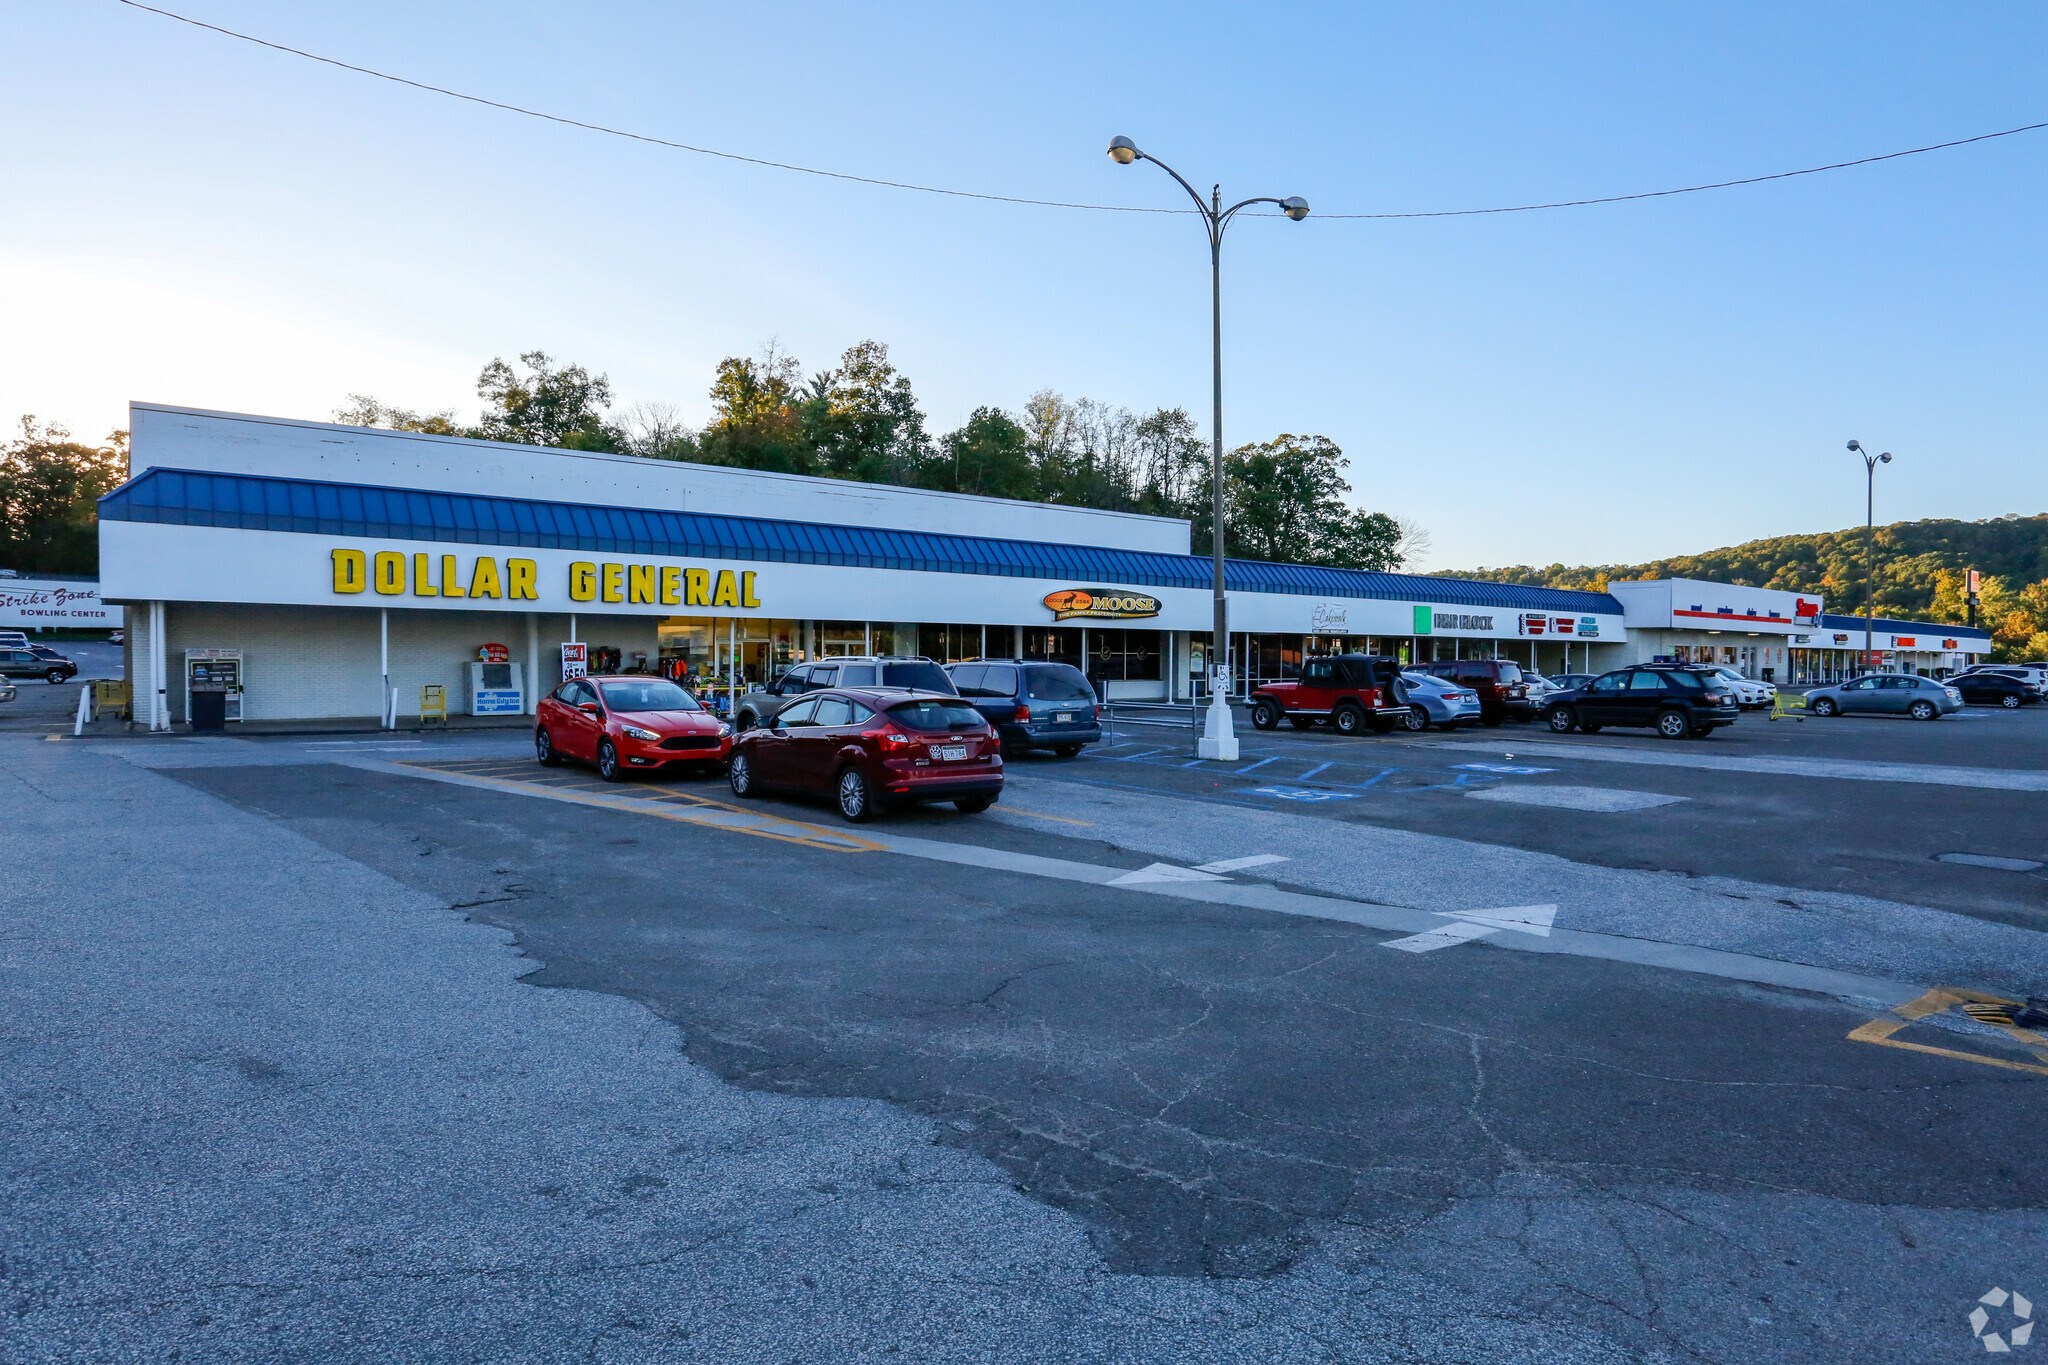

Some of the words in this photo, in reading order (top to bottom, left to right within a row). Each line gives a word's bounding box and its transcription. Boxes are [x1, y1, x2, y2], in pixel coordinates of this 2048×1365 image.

[330, 548, 540, 601] DOLLAR
[569, 561, 761, 608] GENERAL
[0, 591, 49, 607] Strike
[53, 588, 94, 606] Zone
[1090, 596, 1155, 611] MOOSE
[20, 609, 67, 617] BOWLING
[71, 610, 106, 618] CENTER
[1433, 613, 1458, 629] H&R
[1459, 614, 1494, 631] BLOCK
